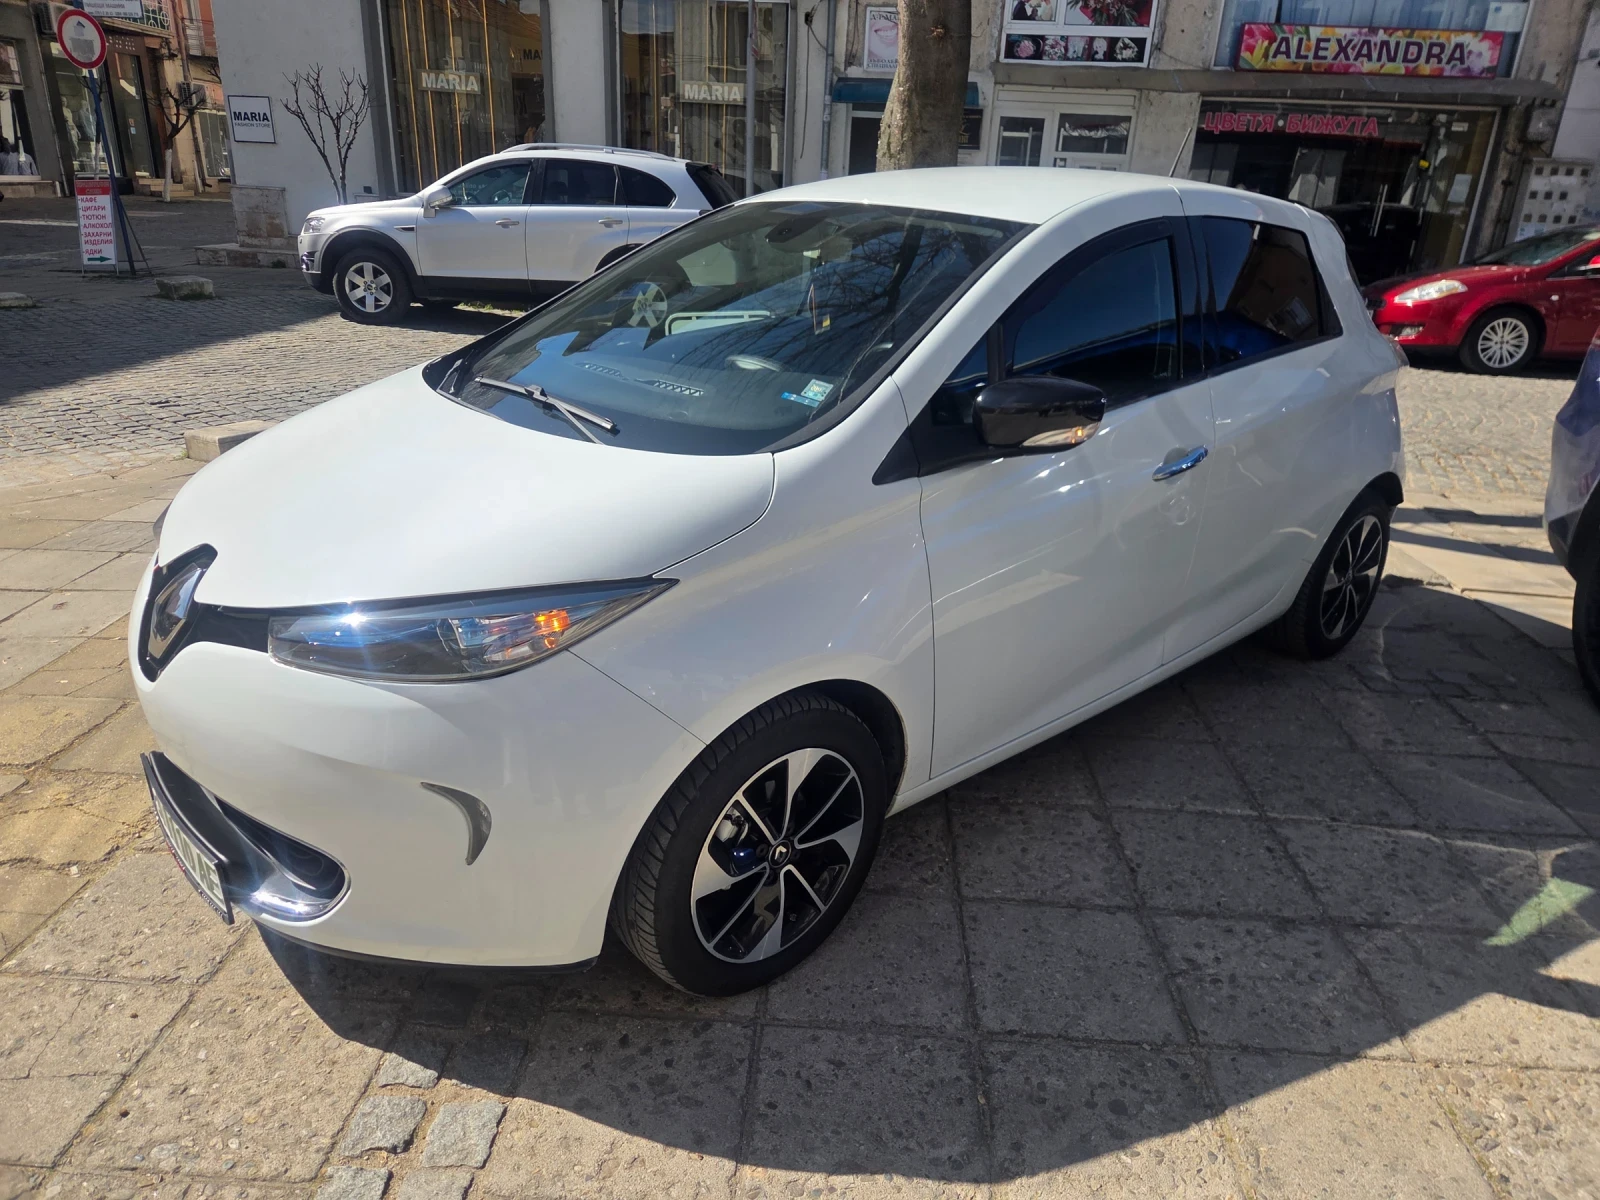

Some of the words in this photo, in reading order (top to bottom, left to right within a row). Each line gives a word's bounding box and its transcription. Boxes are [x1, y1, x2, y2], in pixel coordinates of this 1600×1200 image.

[522, 49, 543, 60] MA
[1271, 36, 1467, 66] ALEXANDRA
[421, 72, 478, 91] MARIA
[684, 84, 741, 101] MARIA
[233, 111, 270, 122] MARIA
[1204, 112, 1276, 134] ЦВЕТЯ
[1286, 113, 1379, 136] БИЖУТА
